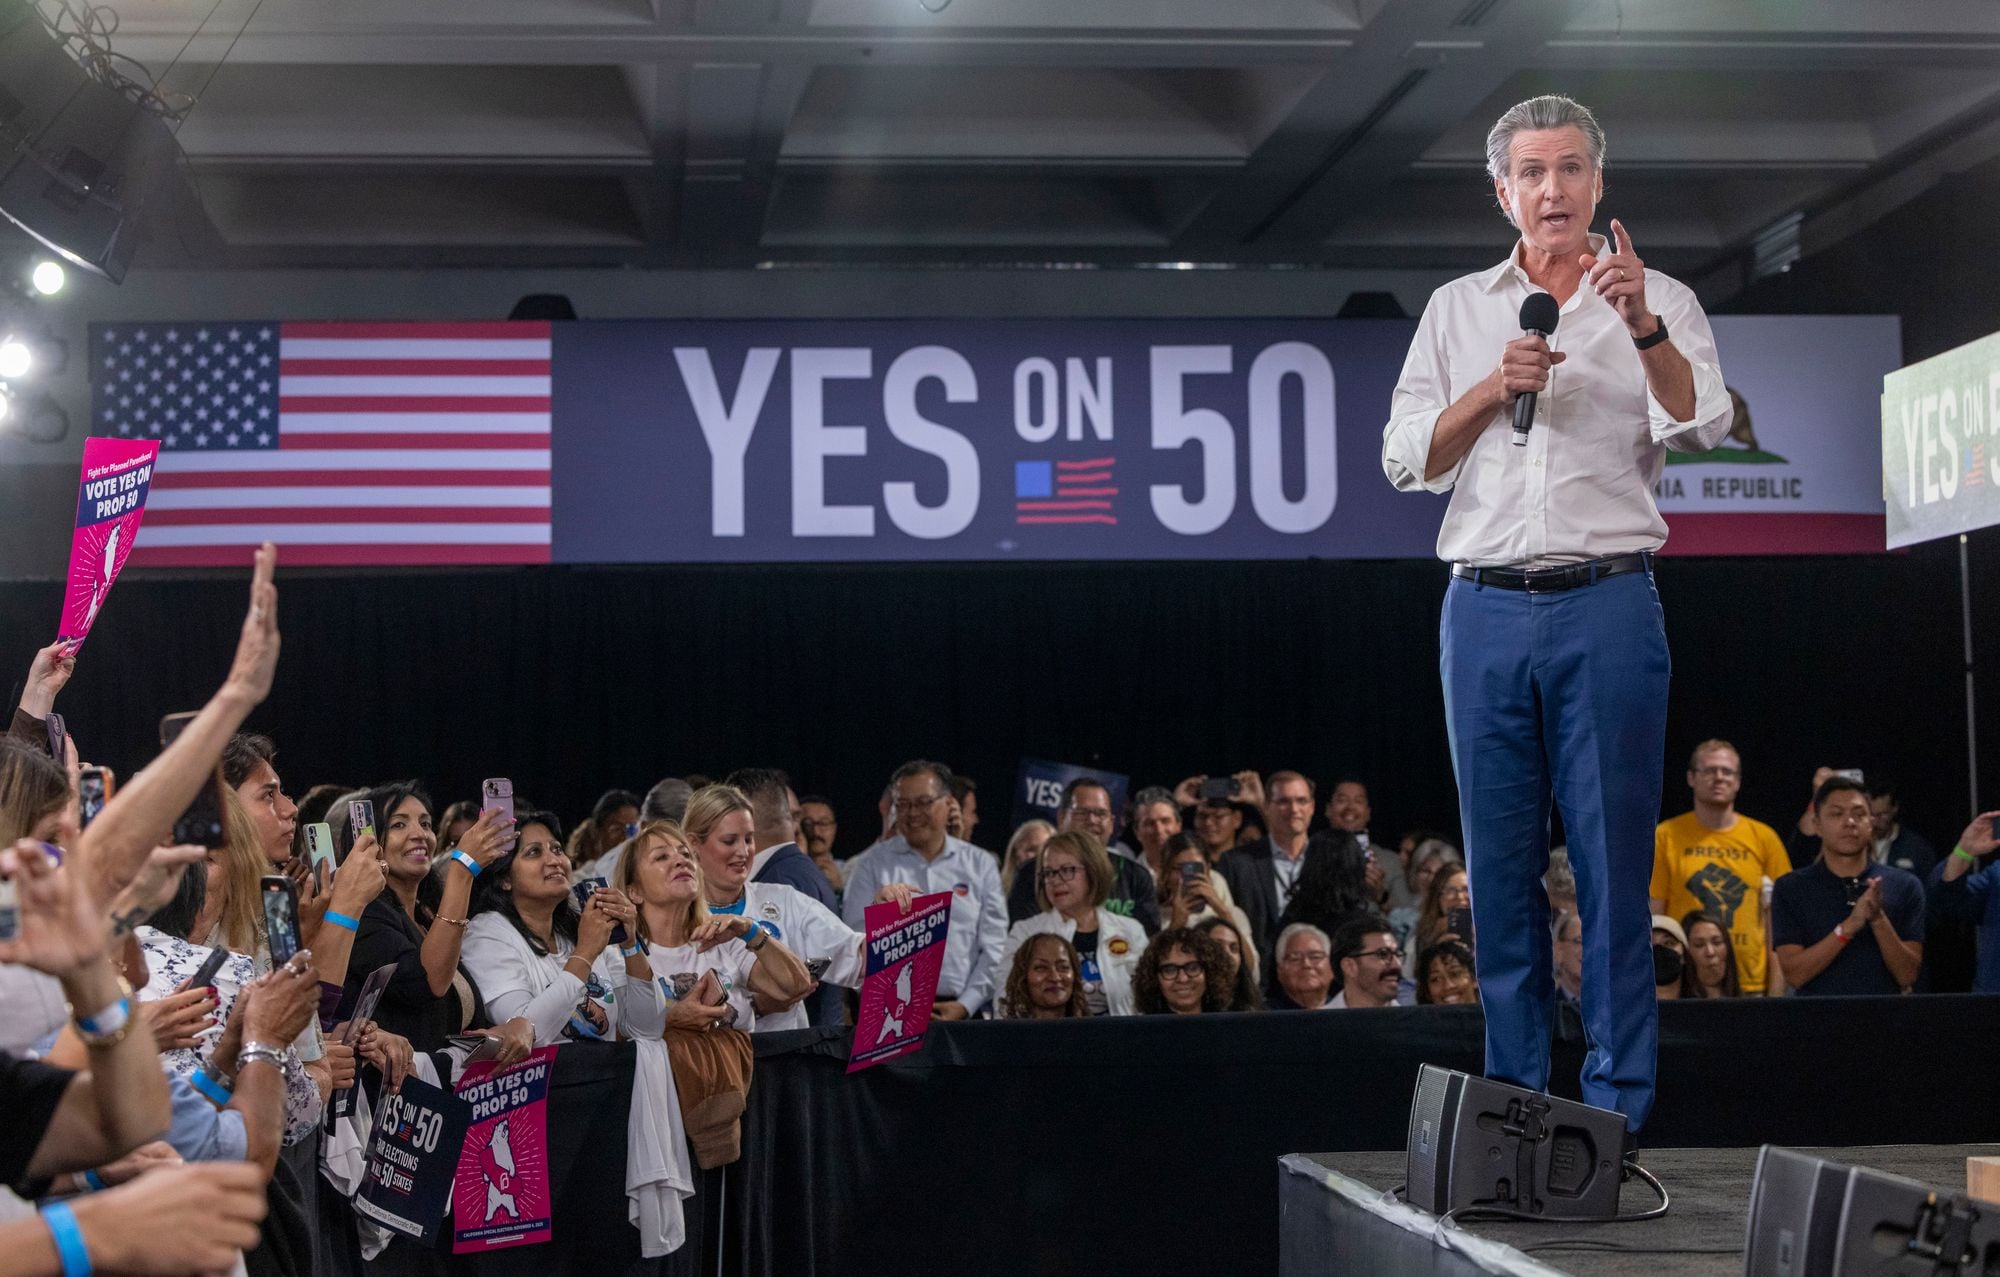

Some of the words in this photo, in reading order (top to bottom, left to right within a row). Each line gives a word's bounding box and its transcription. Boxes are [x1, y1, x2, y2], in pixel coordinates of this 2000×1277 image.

[674, 345, 981, 539] YES
[1014, 357, 1113, 442] ON
[1149, 341, 1337, 536] 50
[1901, 388, 1959, 508] YES
[1963, 382, 1983, 439] ON
[88, 467, 101, 479] Fight
[101, 465, 109, 475] for
[110, 459, 129, 473] Planned
[130, 449, 153, 467] Parenthood
[86, 478, 117, 500] VOTE
[119, 471, 137, 492] YES
[137, 464, 151, 485] ON
[1701, 478, 1802, 499] REPUBLIC
[97, 495, 125, 518] PROP
[126, 489, 138, 509] 50
[1026, 776, 1064, 809] YES
[1684, 846, 1748, 860] #RESIST
[871, 928, 885, 938] Fight
[885, 924, 893, 933] for
[894, 913, 914, 927] Planned
[915, 900, 943, 917] Parenthood
[871, 930, 903, 955] VOTE
[904, 919, 926, 939] YES
[927, 909, 946, 928] ON
[884, 940, 916, 966] PROP
[918, 931, 932, 949] 50
[510, 1053, 546, 1069] Parenthood
[462, 1076, 476, 1088] Fight
[476, 1074, 485, 1083] for
[496, 1072, 522, 1092] YES
[524, 1064, 546, 1083] ON
[472, 1094, 508, 1121] PROP
[511, 1086, 528, 1106] 50
[402, 1102, 417, 1124] ON
[412, 1106, 443, 1153] 50
[385, 1143, 419, 1171] ELECTIONS
[380, 1162, 394, 1188] 50
[392, 1172, 413, 1191] STATES
